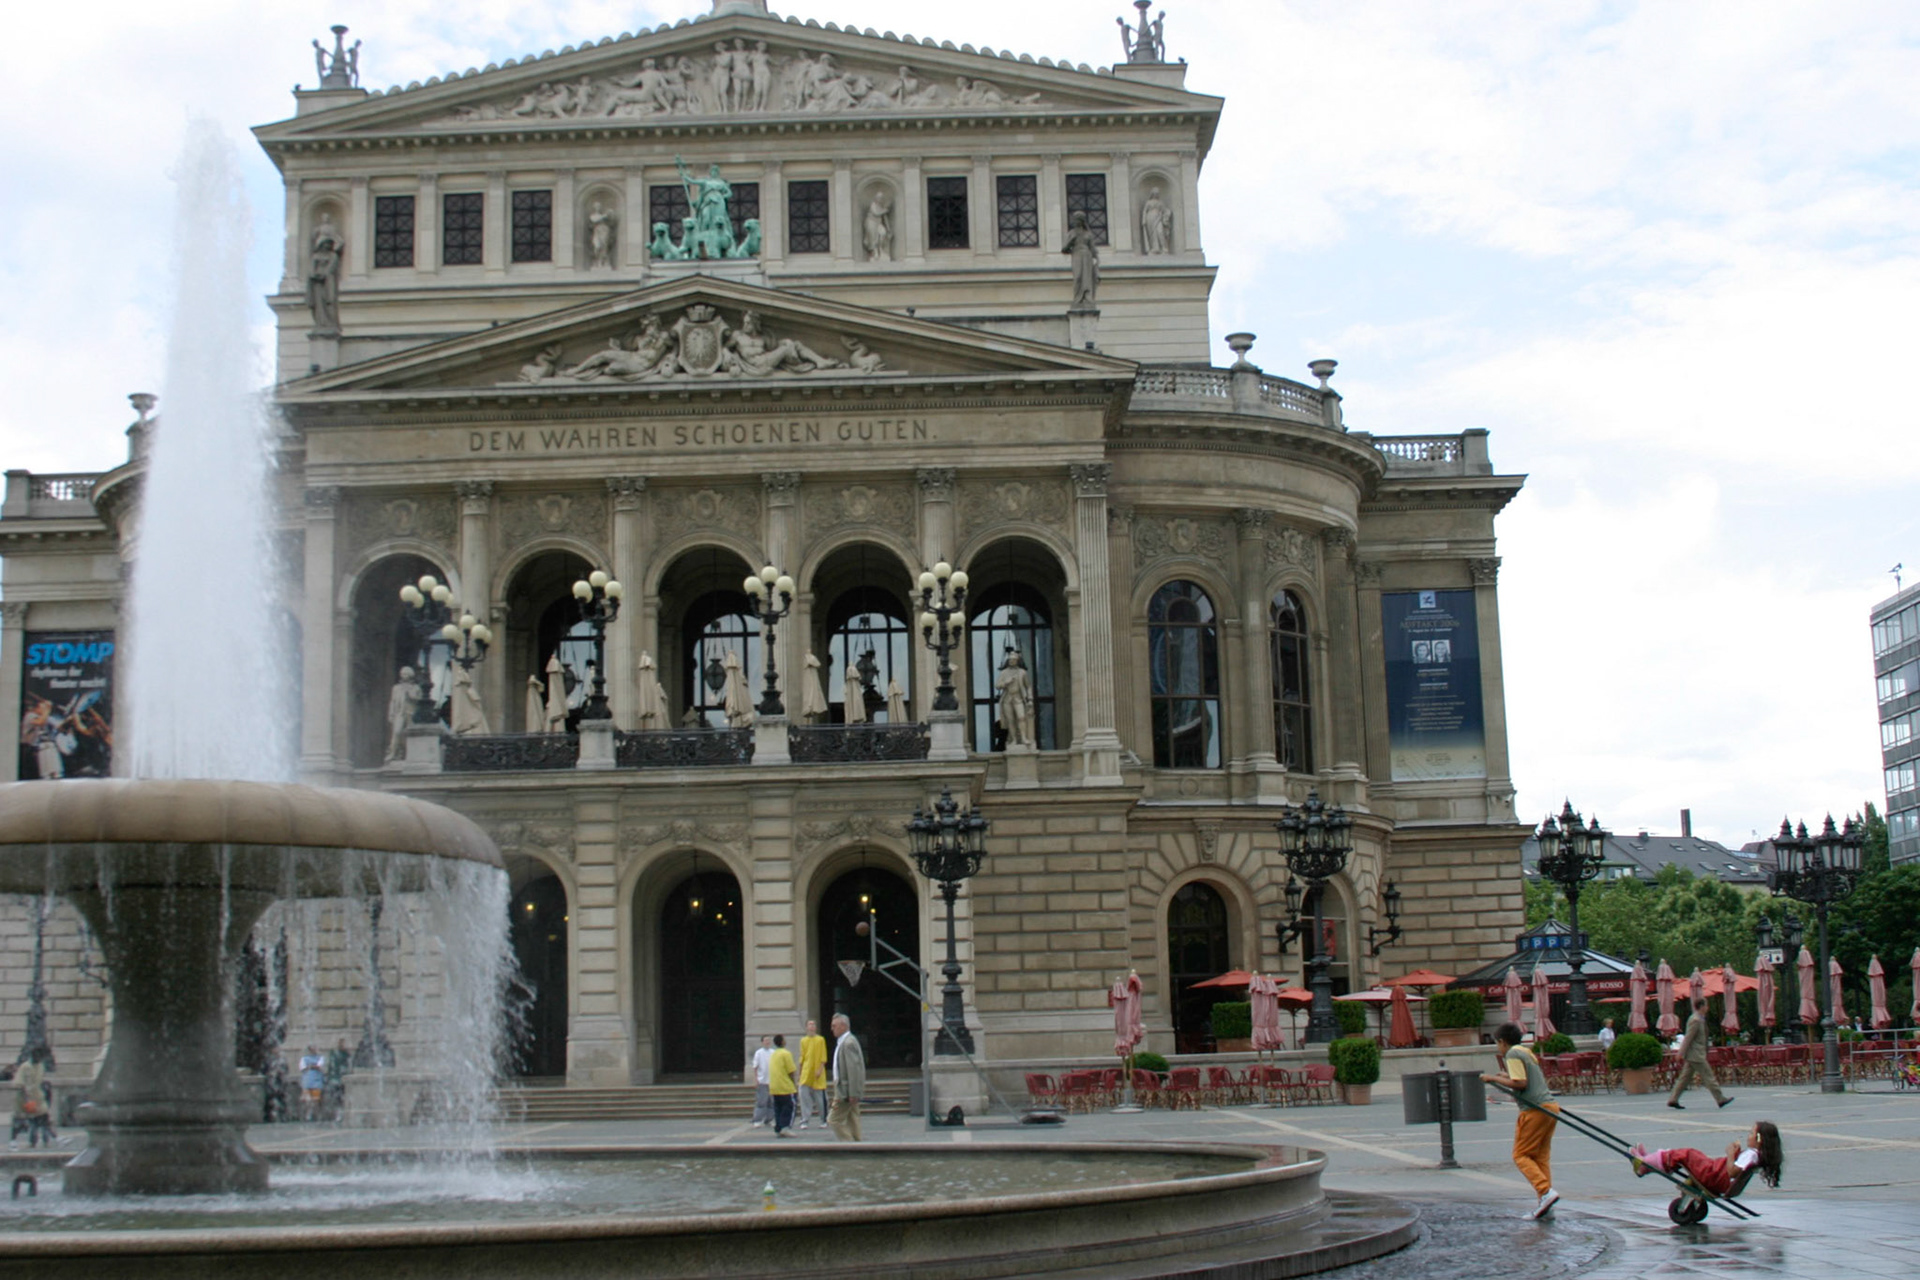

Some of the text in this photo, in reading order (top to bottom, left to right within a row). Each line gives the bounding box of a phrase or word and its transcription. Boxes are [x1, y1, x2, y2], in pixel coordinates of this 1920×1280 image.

[469, 430, 525, 451] DEM
[540, 426, 657, 449] WAHREN
[674, 422, 821, 446] SCHOENEN
[26, 641, 115, 665] STOMP
[1600, 981, 1624, 989] ROSSO
